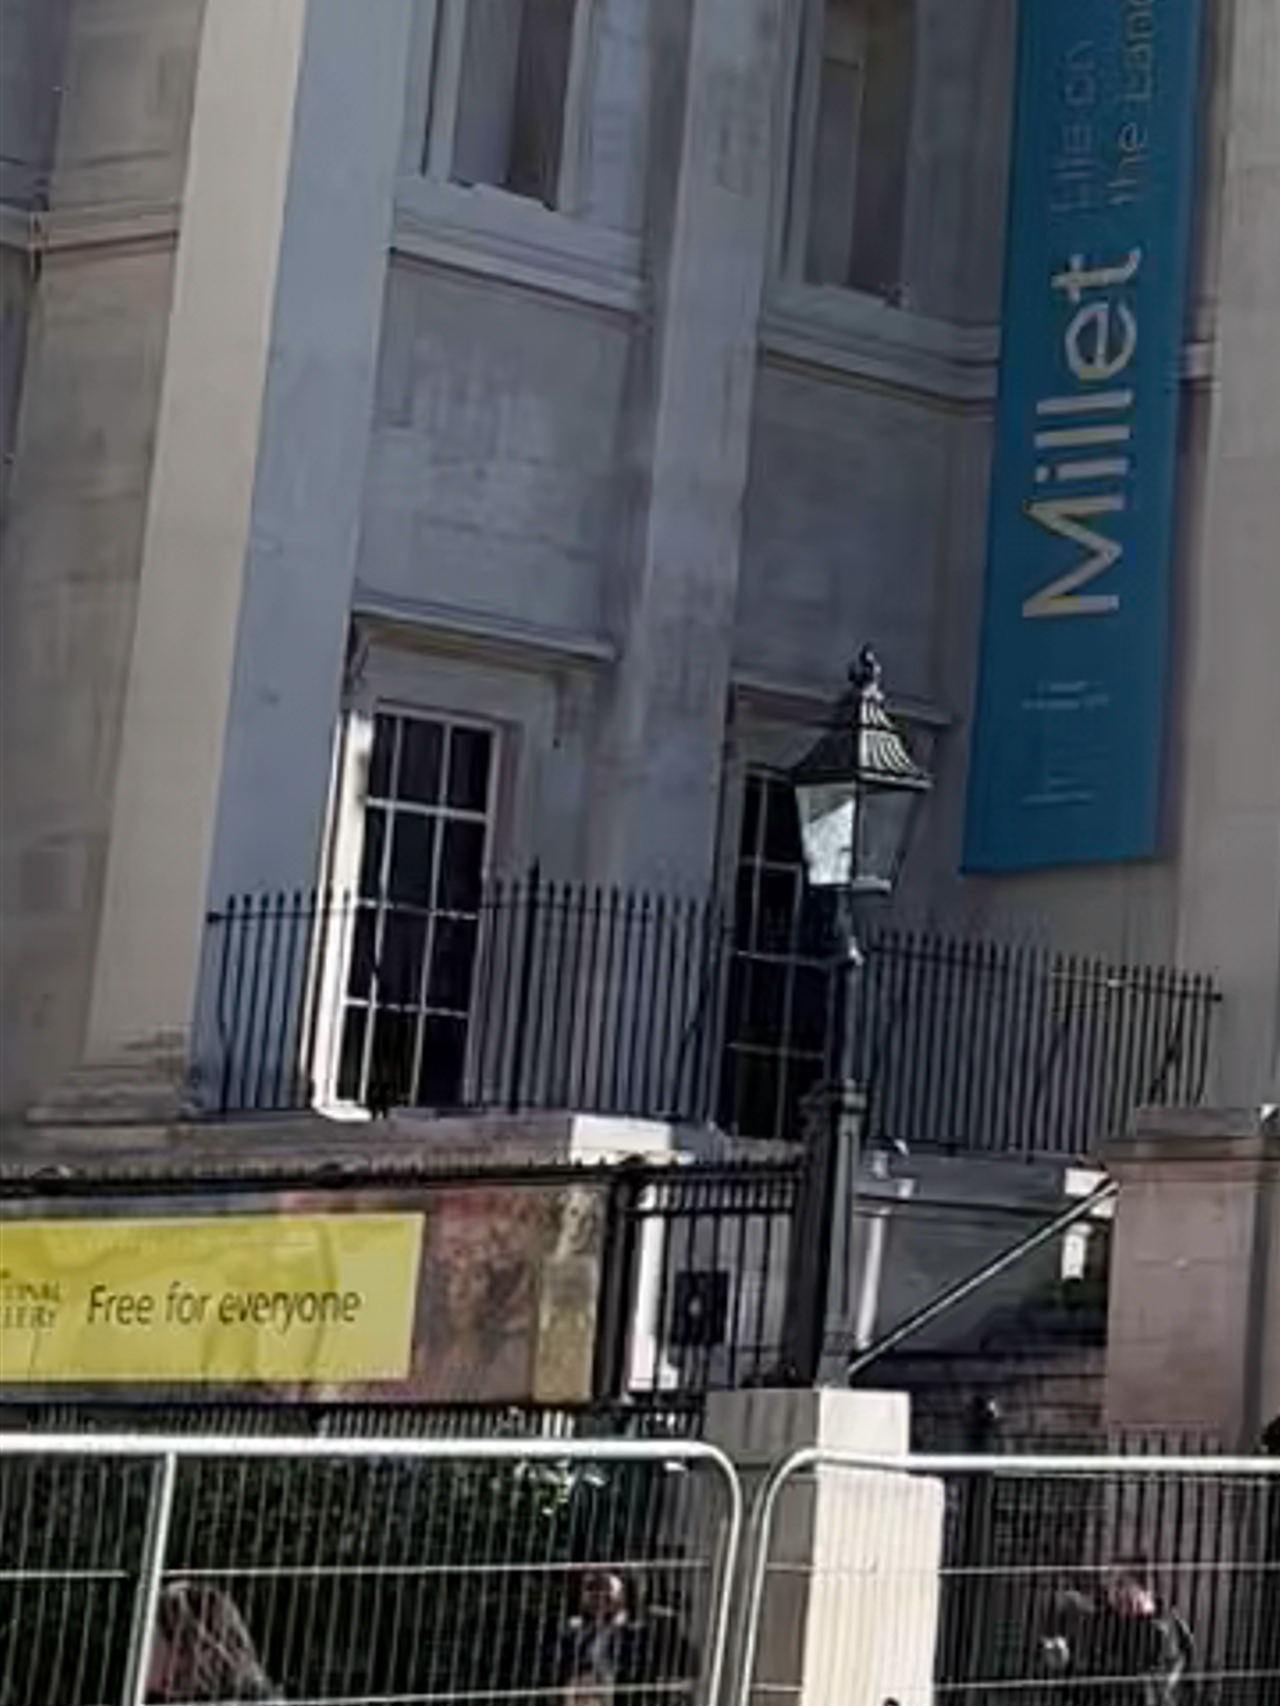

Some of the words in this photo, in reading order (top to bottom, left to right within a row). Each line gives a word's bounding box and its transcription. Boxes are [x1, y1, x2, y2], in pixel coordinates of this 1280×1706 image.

[1022, 246, 1142, 617] Millet
[87, 1284, 154, 1326] Free
[165, 1280, 211, 1324] for
[217, 1289, 361, 1336] everyone
